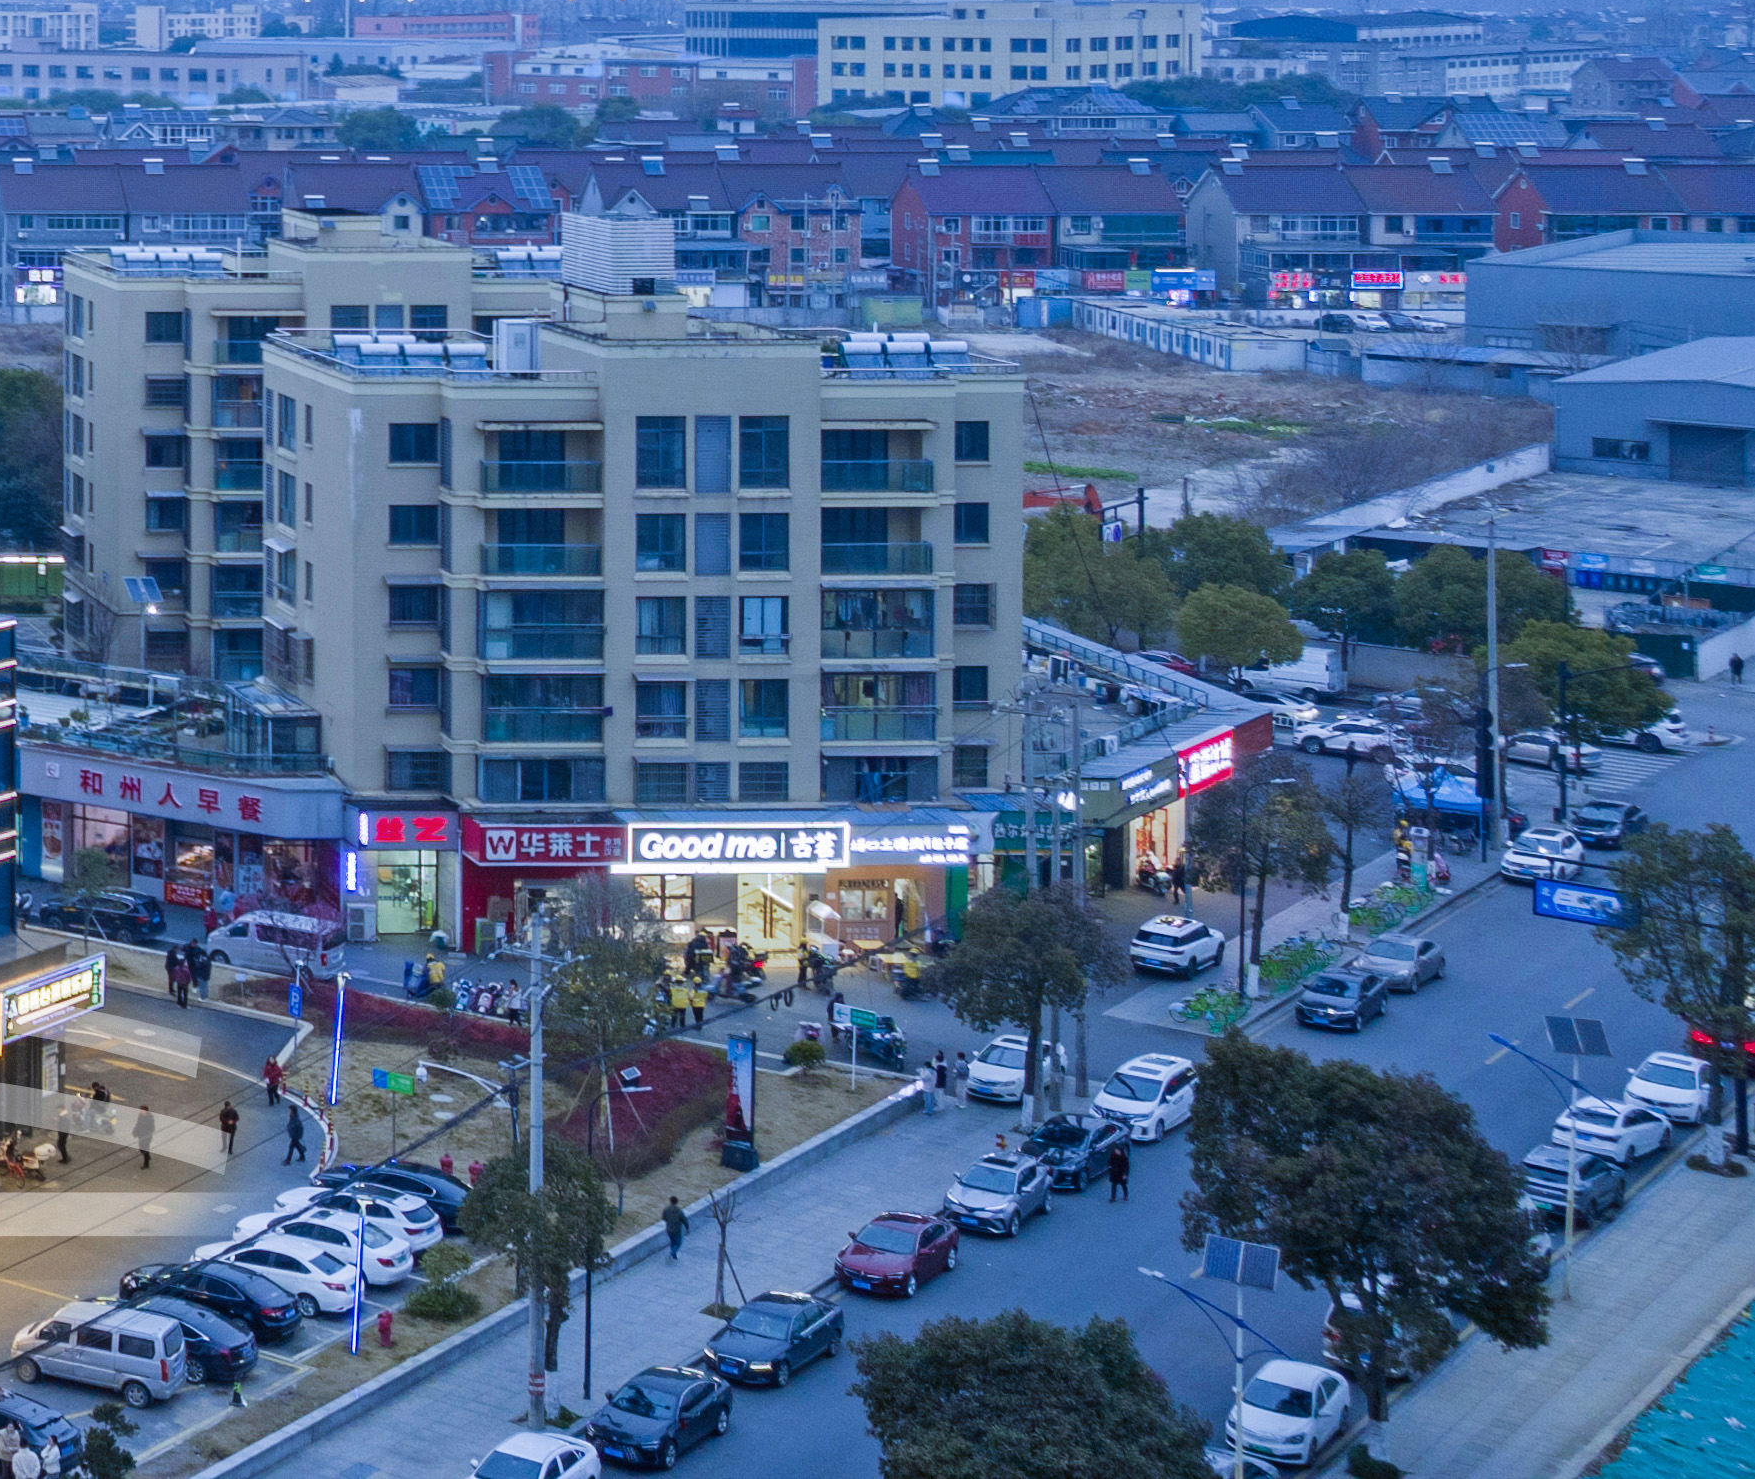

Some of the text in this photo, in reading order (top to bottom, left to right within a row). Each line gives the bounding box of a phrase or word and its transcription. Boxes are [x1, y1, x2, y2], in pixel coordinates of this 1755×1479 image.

[80, 769, 263, 822] 和州人早餐
[521, 832, 600, 858] 华莱士
[640, 832, 777, 859] Good me
[789, 832, 839, 860] 古茗
